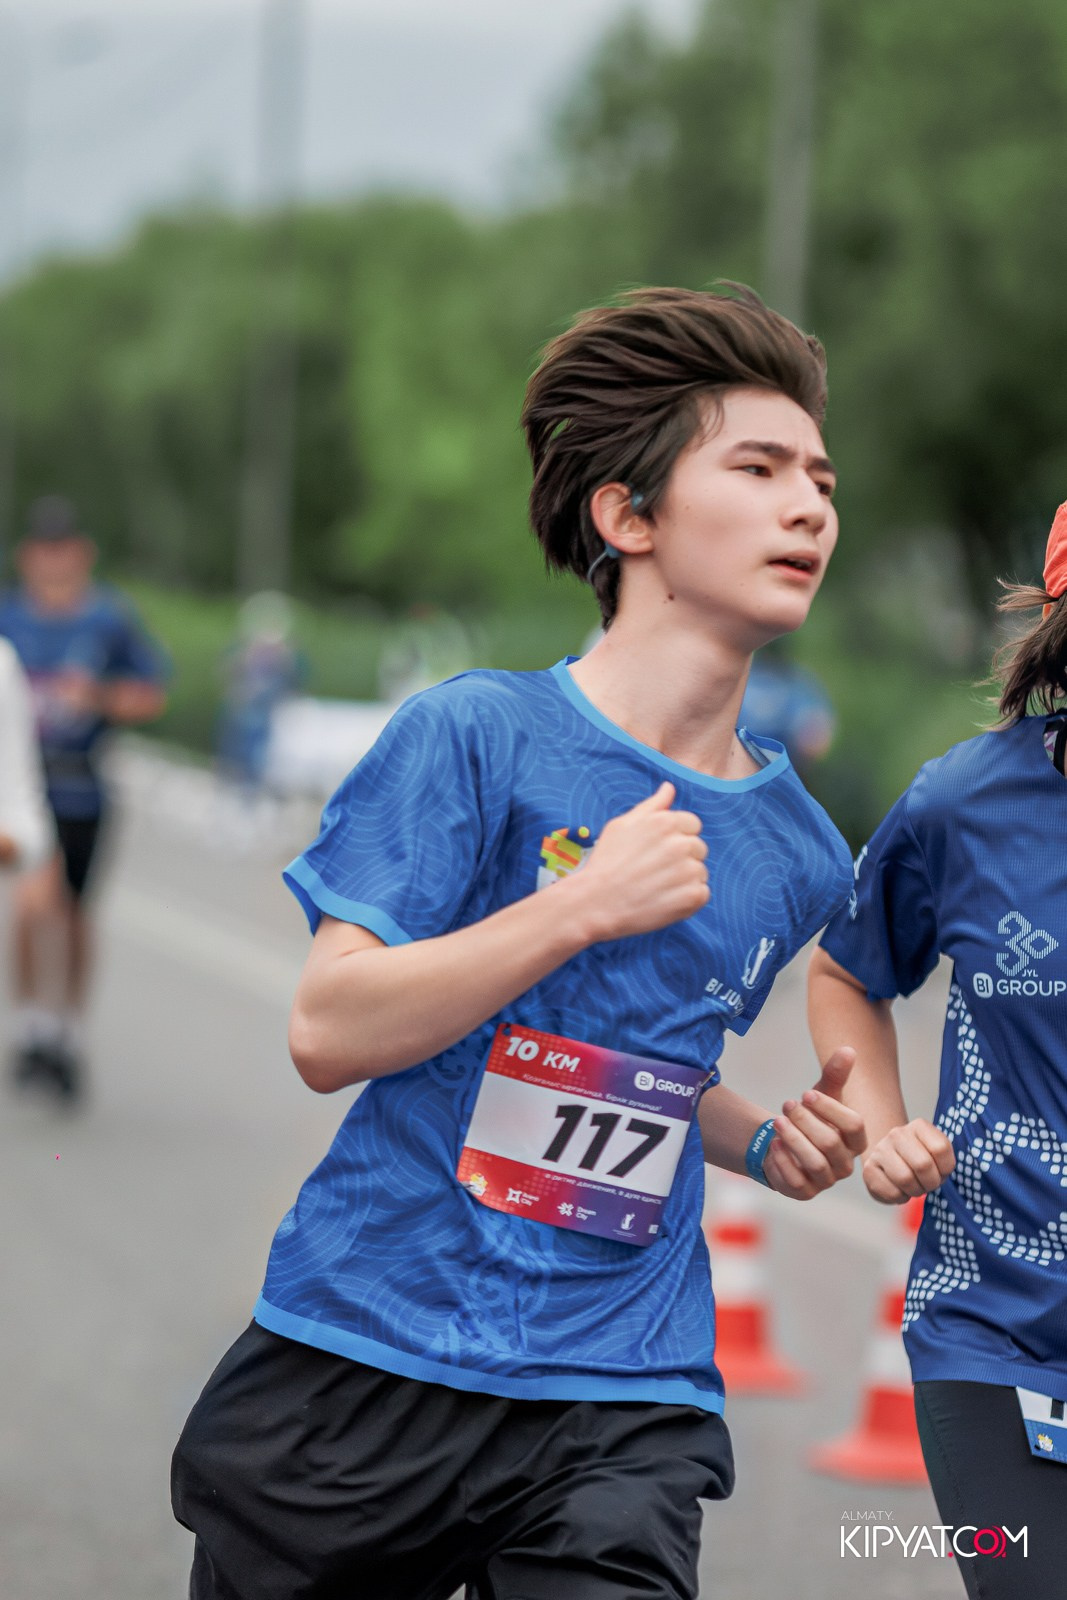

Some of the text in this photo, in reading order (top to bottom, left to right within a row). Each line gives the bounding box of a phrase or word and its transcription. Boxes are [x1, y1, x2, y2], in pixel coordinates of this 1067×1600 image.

[1022, 969, 1038, 977] JYL
[705, 977, 724, 995] BI
[975, 976, 1067, 997] BI GROUP
[505, 1036, 581, 1073] 10 KM
[655, 1078, 696, 1097] GROUP
[541, 1104, 671, 1179] 117
[752, 1129, 768, 1153] RUN
